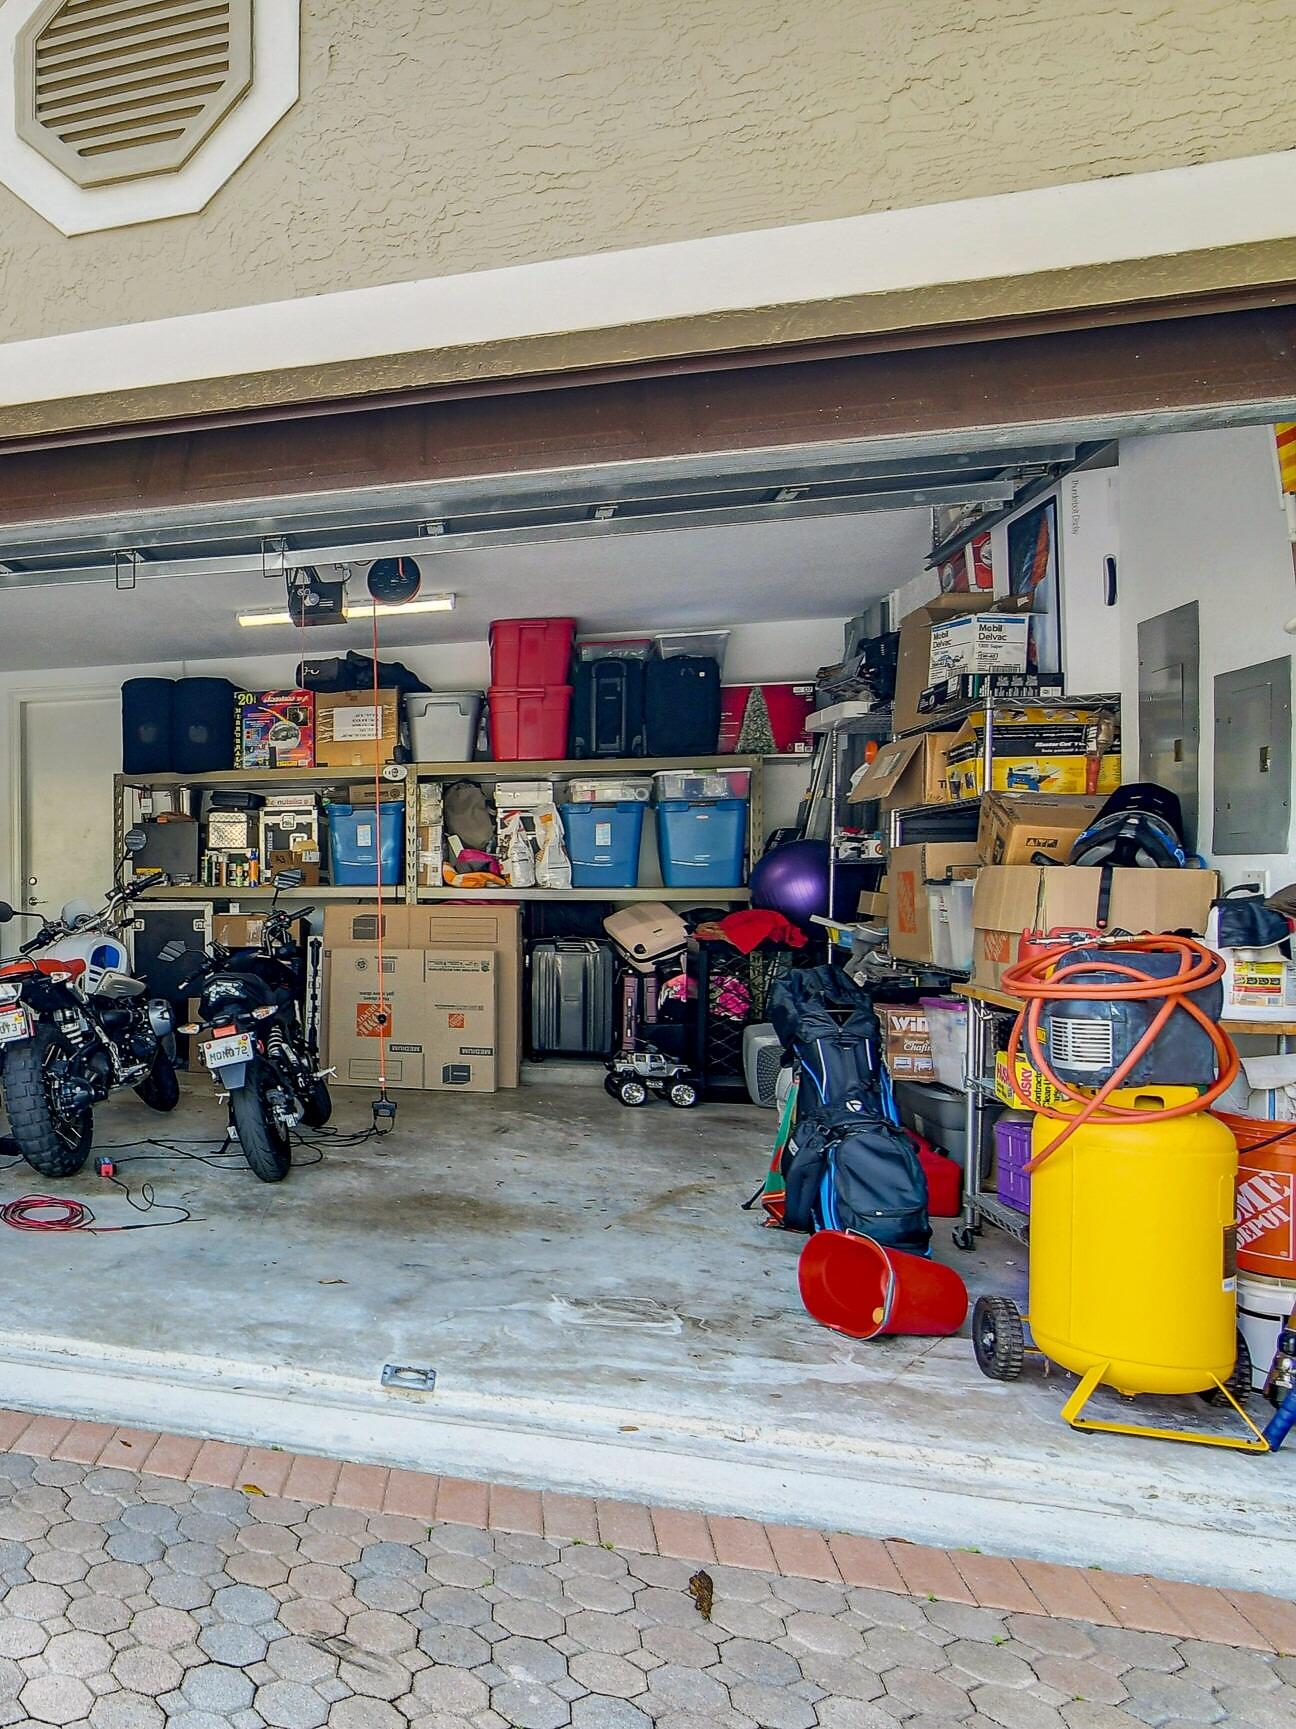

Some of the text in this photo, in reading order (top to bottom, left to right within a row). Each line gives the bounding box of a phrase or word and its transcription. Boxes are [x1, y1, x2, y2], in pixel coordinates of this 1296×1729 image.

[978, 624, 1003, 632] Mobil
[978, 632, 1008, 641] Delvac
[1020, 1067, 1032, 1103] USKY
